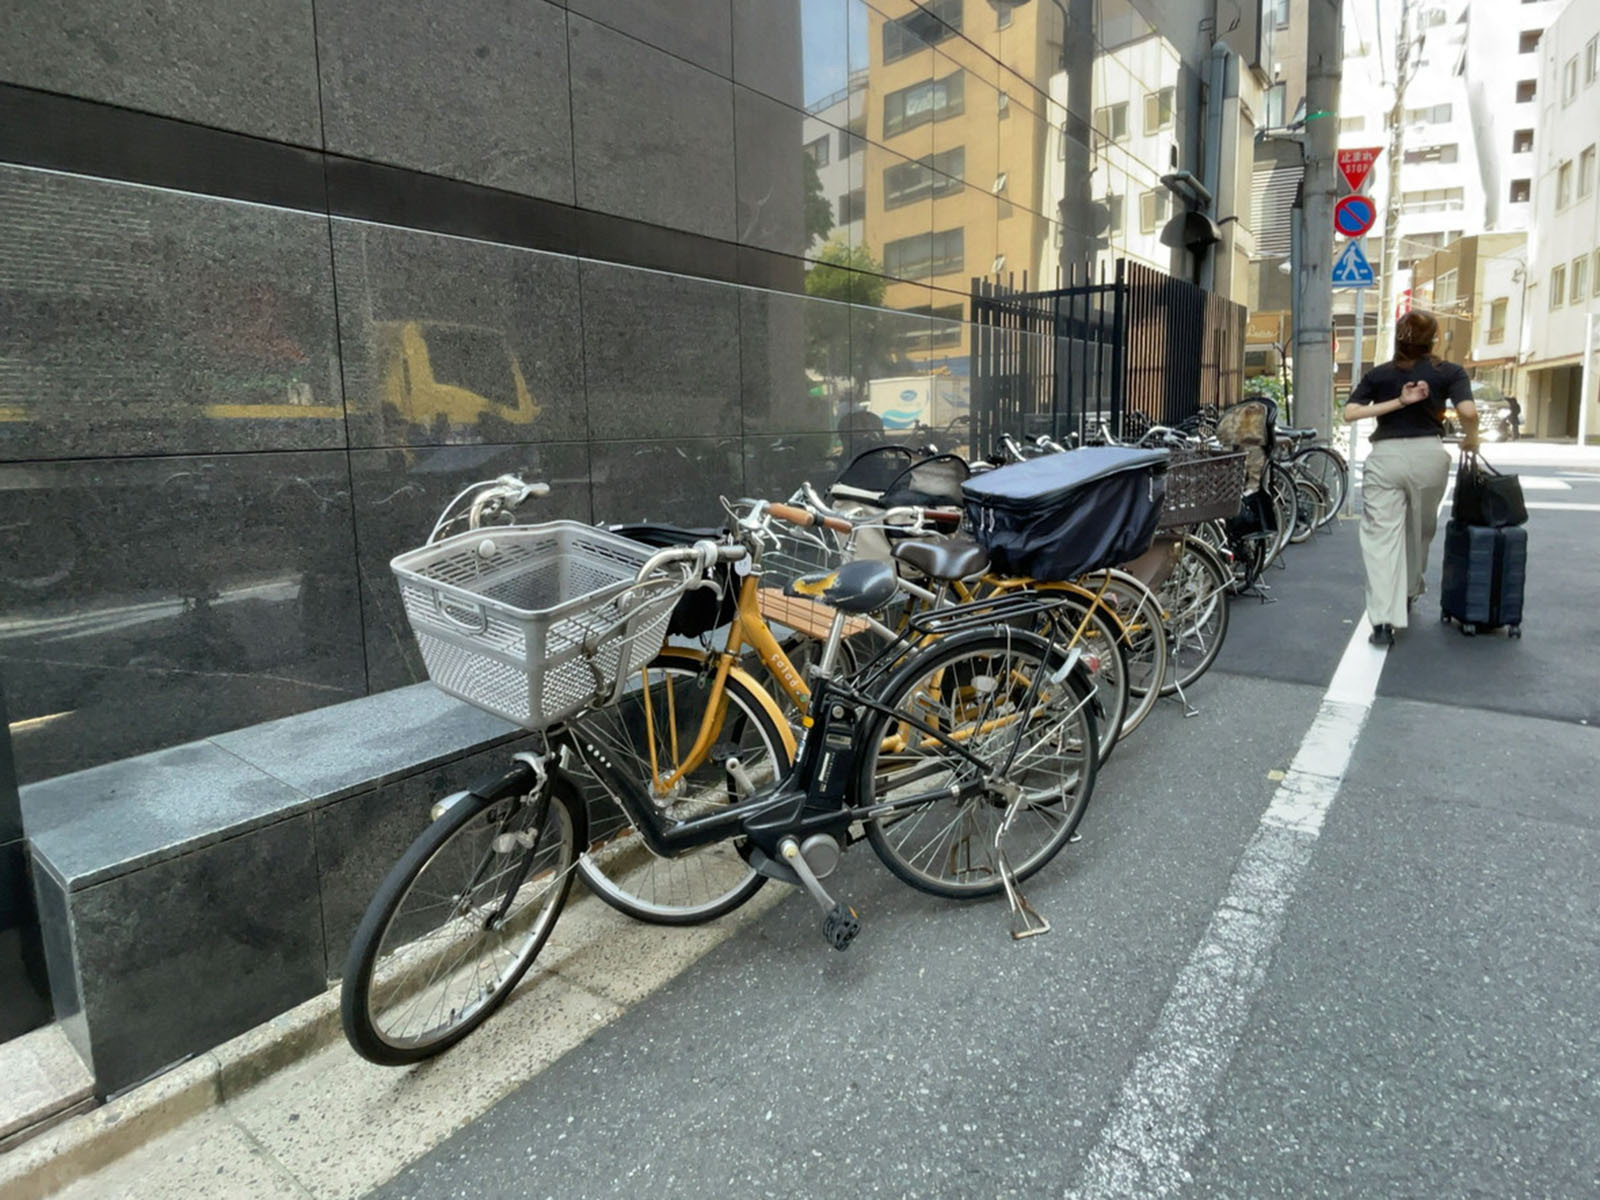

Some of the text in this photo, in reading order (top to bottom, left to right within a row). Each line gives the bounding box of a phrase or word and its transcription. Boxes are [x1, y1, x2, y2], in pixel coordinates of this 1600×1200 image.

[1341, 152, 1373, 163] 止まれ
[1345, 164, 1369, 174] STOP
